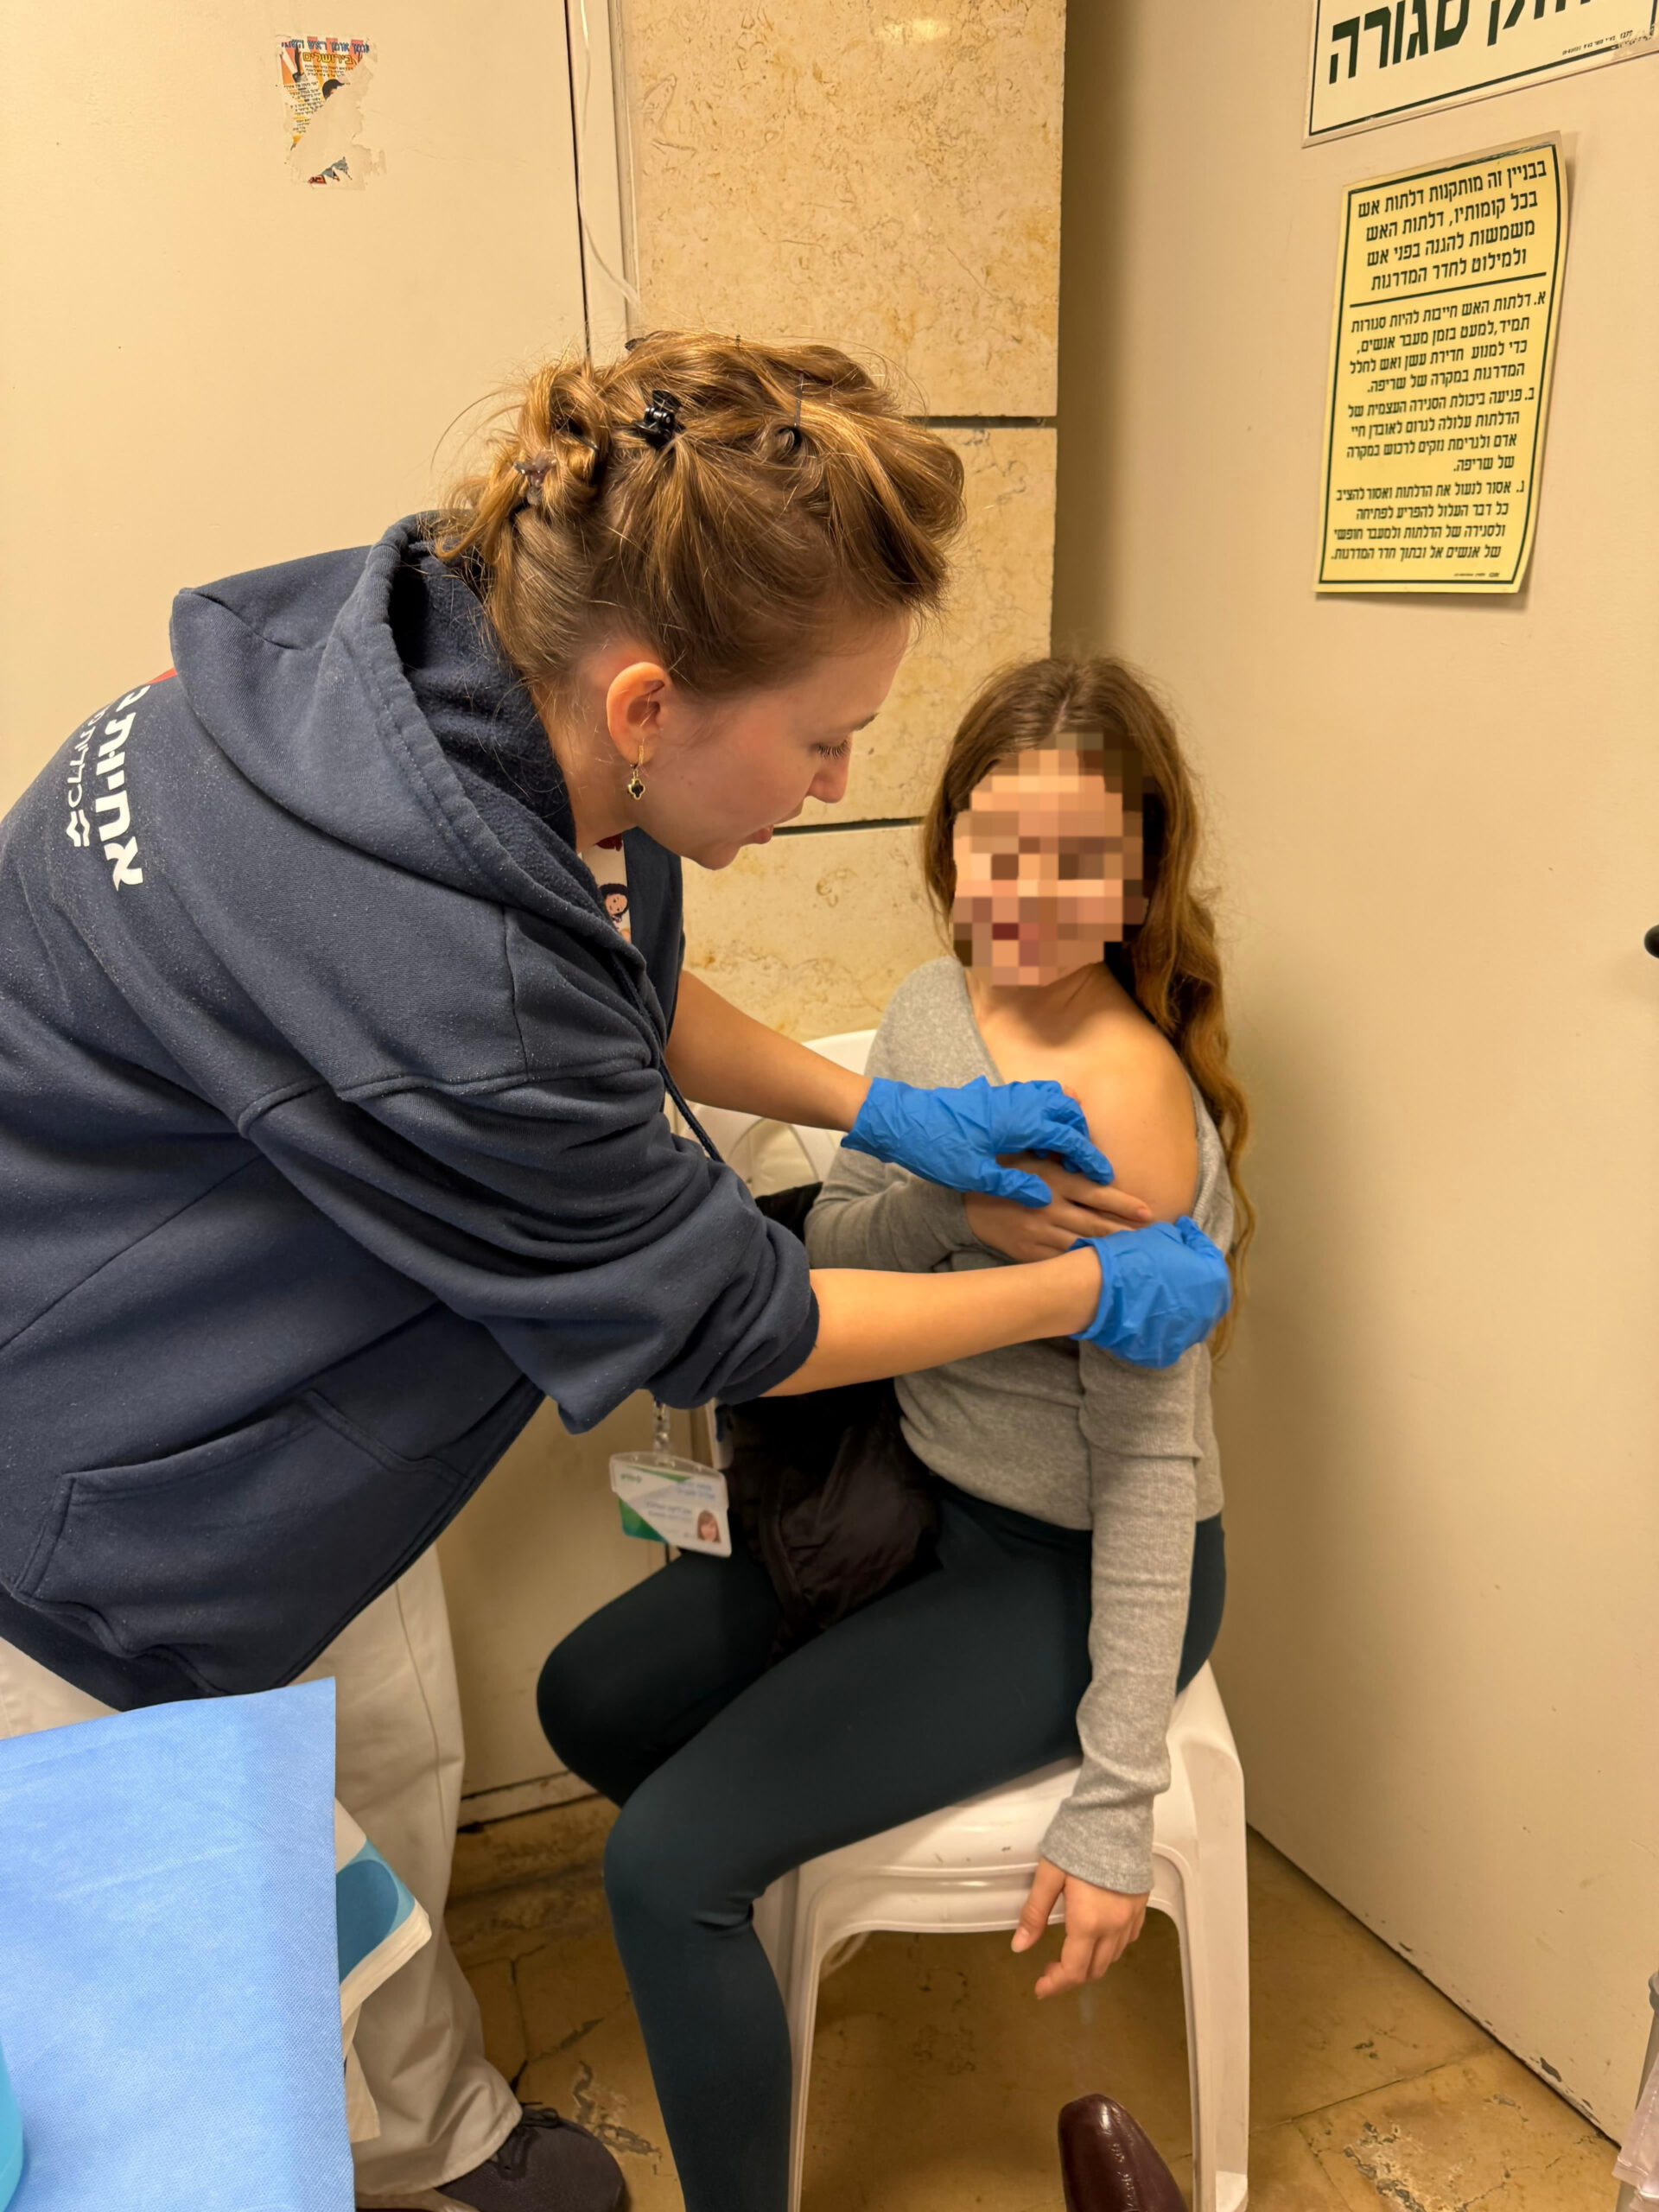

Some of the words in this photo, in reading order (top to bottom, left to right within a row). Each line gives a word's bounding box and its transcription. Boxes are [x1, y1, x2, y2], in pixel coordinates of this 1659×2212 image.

[1329, 0, 1469, 85] סגורה
[302, 52, 353, 65] בירושלים
[1487, 170, 1502, 189] זה
[1506, 160, 1547, 189] בבניין
[1429, 175, 1484, 203] מותקנות
[1384, 189, 1424, 213] דלתות
[1510, 190, 1538, 212] בכל
[1358, 200, 1380, 219] אש
[1449, 197, 1505, 227] קומותיו,
[1402, 211, 1445, 235] דלתות
[1366, 221, 1398, 242] האש
[1469, 219, 1535, 247] משמשות
[1394, 242, 1421, 261] בפני
[1425, 232, 1465, 256] להגנה
[1367, 249, 1389, 267] אש
[1471, 247, 1527, 273] ולמילוט
[1432, 257, 1467, 280] לחדר
[1370, 267, 1427, 291] המדרגות
[1461, 300, 1490, 316] האש
[1492, 293, 1532, 312] דלתות
[1389, 309, 1420, 327] להיות
[1422, 305, 1458, 322] חייבות
[1351, 316, 1387, 334] סגורות
[1399, 331, 1428, 346] מעבר
[1432, 327, 1457, 346] בזמן
[1357, 336, 1395, 354] אנשים,
[1471, 340, 1505, 359] למנוע
[1509, 340, 1528, 354] כדי
[1379, 356, 1402, 371] ואש
[1404, 353, 1427, 372] עשן
[1429, 348, 1464, 365] חדירת
[1350, 358, 1376, 374] לחלל
[1472, 362, 1525, 381] המדרגות
[1367, 377, 1407, 393] שריפה.
[1410, 373, 1427, 388] של
[1430, 369, 1469, 388] במקרה
[1449, 392, 1485, 408] ביכולת
[1489, 388, 1522, 404] פגיעה
[1348, 404, 1364, 418] של
[1367, 401, 1407, 416] העצמית
[1409, 397, 1446, 412] הסגירה
[1405, 416, 1435, 434] לגרום
[1438, 415, 1472, 430] עלולה
[1475, 410, 1520, 428] הדלתות
[1351, 425, 1366, 437] חיי
[1369, 420, 1403, 440] לאובדן
[1383, 440, 1415, 455] לרכוש
[1418, 439, 1445, 455] נזקים
[1447, 434, 1491, 451] ולגרימת
[1493, 433, 1517, 448] אדם
[1346, 444, 1380, 461] במקרה
[1453, 457, 1494, 472] שריפה.
[1497, 454, 1515, 469] של
[1336, 487, 1365, 501] להציב
[1366, 486, 1393, 499] ואסור
[1395, 484, 1433, 499] הדלתות
[1435, 484, 1452, 497] את
[1454, 480, 1483, 496] לנעול
[1485, 480, 1511, 494] אסור
[1356, 505, 1394, 520] לפתיחה
[1396, 504, 1434, 518] להפריע
[1437, 503, 1469, 518] העלול
[1472, 503, 1492, 516] דבר
[1496, 500, 1510, 516] כל
[1334, 528, 1363, 540] חופשי
[1366, 525, 1402, 539] ולמעבר
[1403, 524, 1443, 539] הדלתות
[1446, 524, 1462, 538] של
[1464, 522, 1506, 537] ולסגירה
[1331, 548, 1375, 560] המדרגות.
[1378, 547, 1396, 559] חדר
[1400, 547, 1427, 562] ובתוך
[1430, 545, 1444, 559] אל
[1446, 546, 1481, 558] אנשים
[1484, 543, 1502, 558] של
